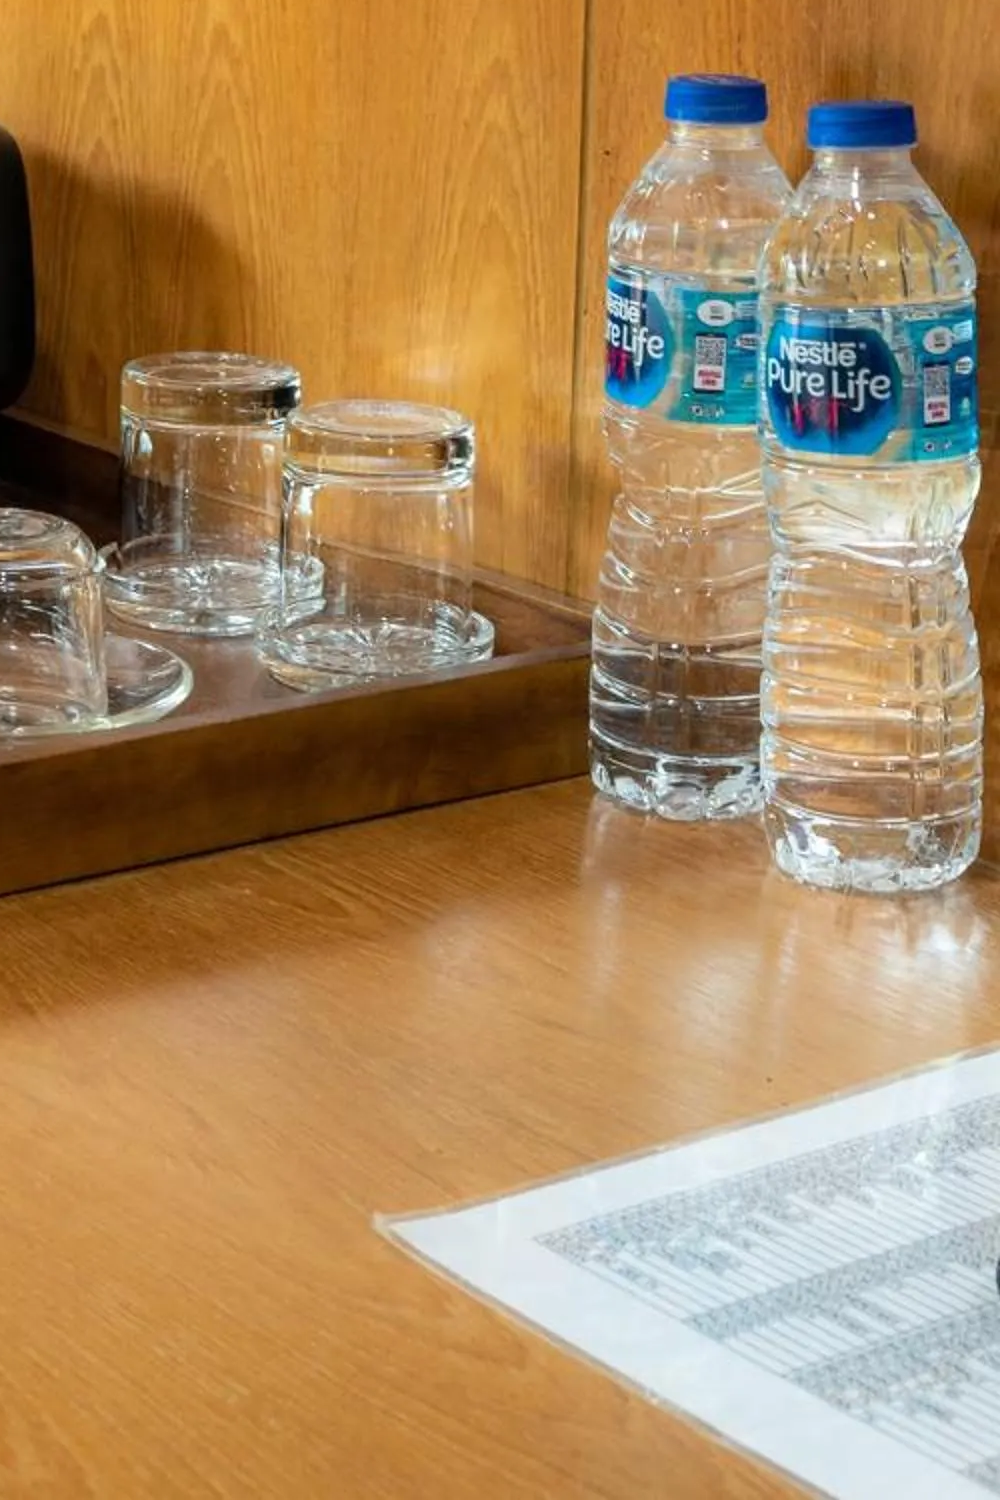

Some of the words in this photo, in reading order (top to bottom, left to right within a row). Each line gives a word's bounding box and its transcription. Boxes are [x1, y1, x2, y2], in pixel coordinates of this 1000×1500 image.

[622, 326, 665, 367] Life
[767, 357, 825, 398] Pure
[831, 368, 893, 413] Life
